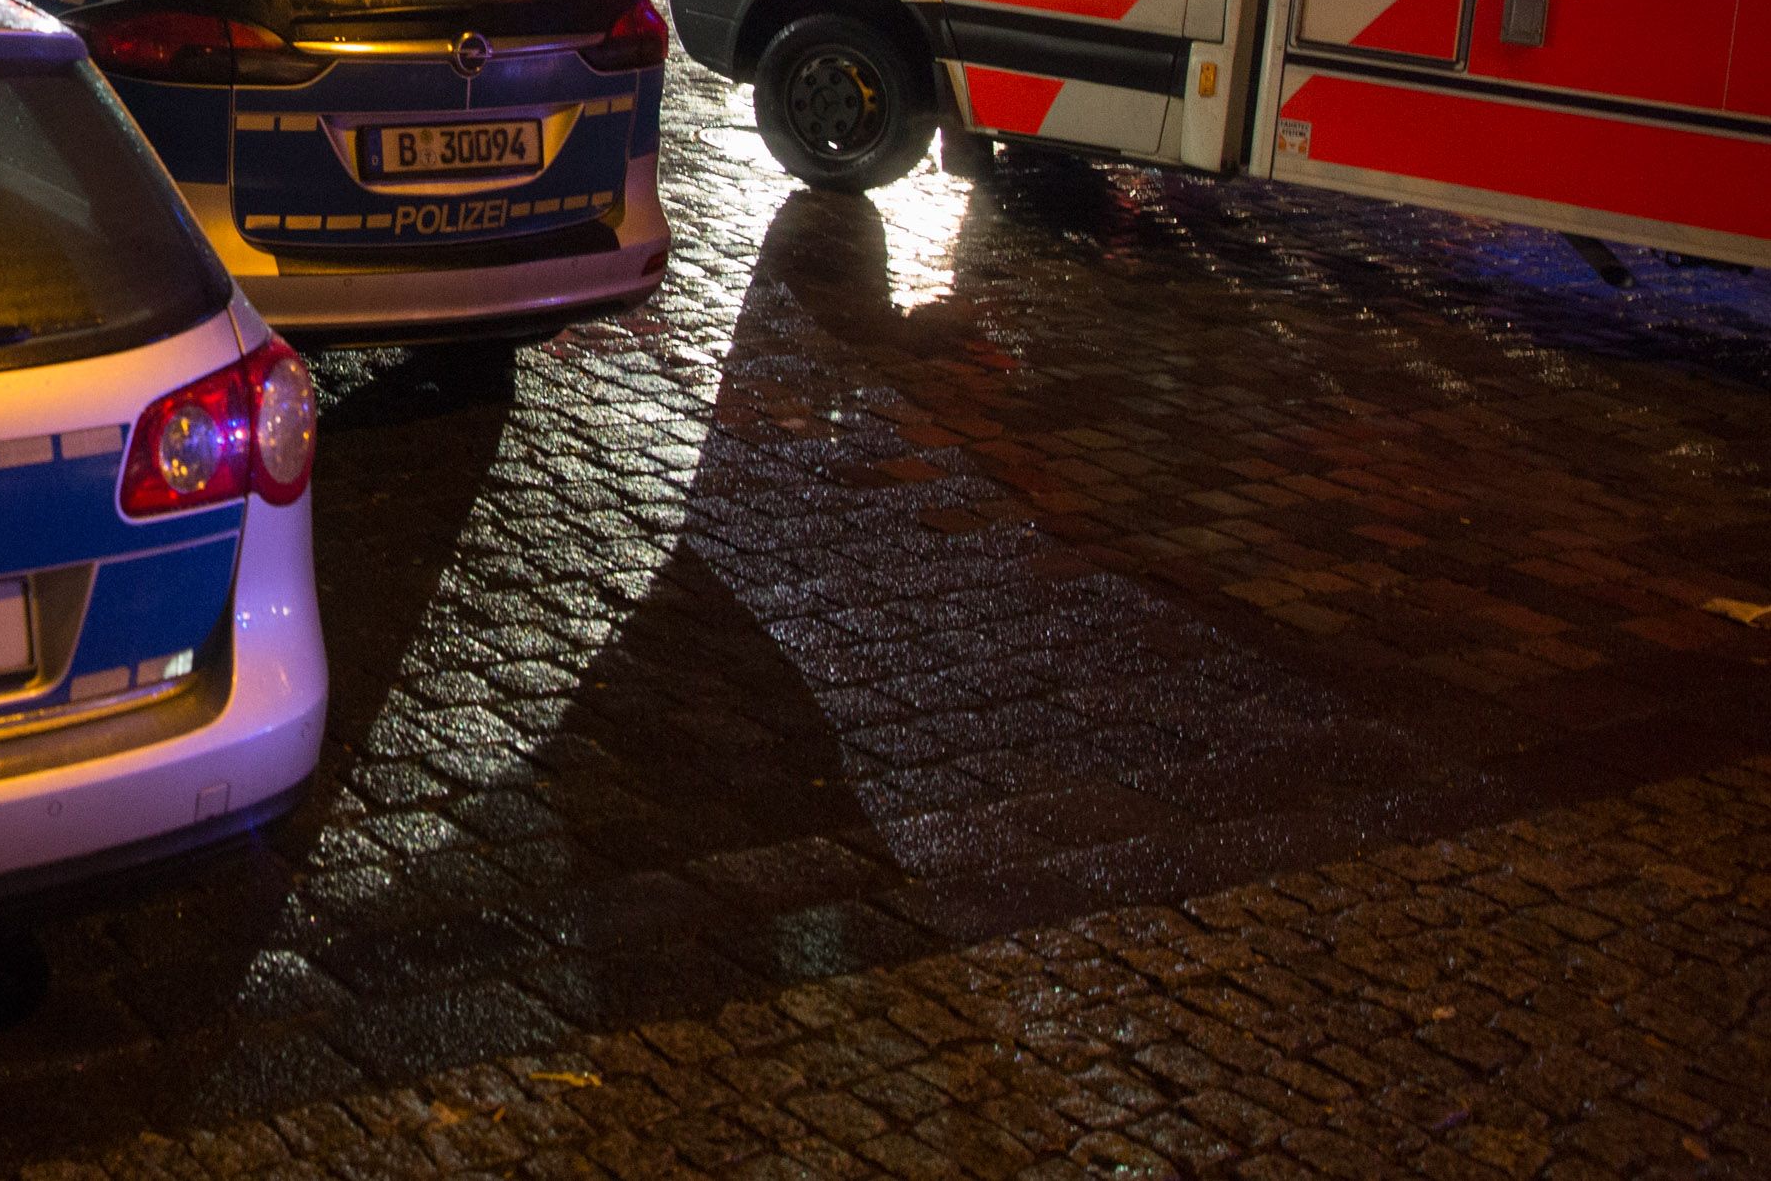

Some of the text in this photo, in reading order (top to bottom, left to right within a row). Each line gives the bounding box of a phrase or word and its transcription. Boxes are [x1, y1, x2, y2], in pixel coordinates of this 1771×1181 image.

[398, 133, 417, 166] B
[439, 128, 526, 164] 30094
[394, 198, 508, 235] POLIZEI
